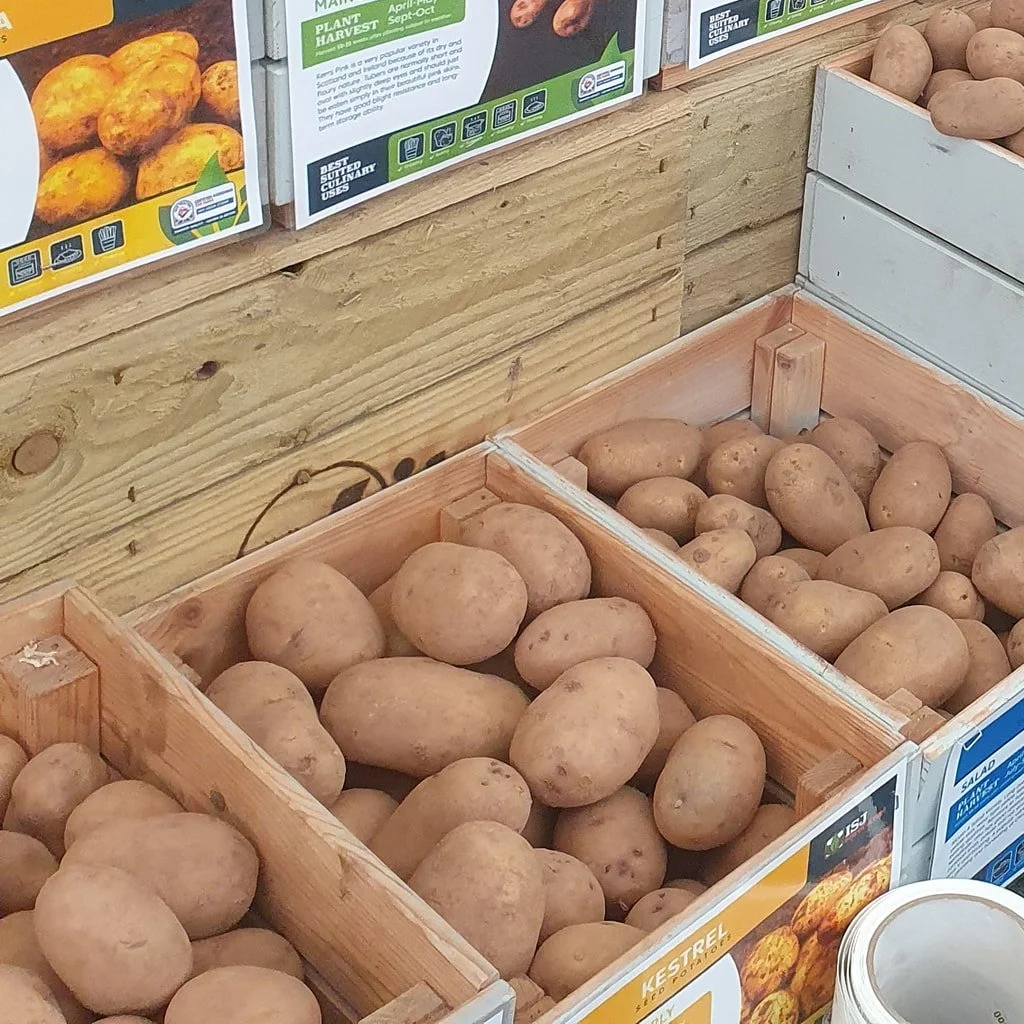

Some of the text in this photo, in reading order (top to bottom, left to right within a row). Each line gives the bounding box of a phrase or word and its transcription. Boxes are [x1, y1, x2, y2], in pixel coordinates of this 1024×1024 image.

[315, 12, 361, 35] PLANT
[315, 6, 435, 48] HARVEST Sept-Oct
[708, 8, 731, 22] BEST
[708, 14, 740, 31] SUITED
[708, 17, 750, 39] CULINARY
[708, 32, 729, 47] USES
[320, 156, 349, 175] BEST
[320, 161, 361, 184] SUITED
[321, 163, 376, 192] CULINARY
[321, 183, 349, 200] USES
[961, 759, 996, 793] SALAD
[956, 777, 1000, 820] HARVEST
[958, 778, 990, 810] PLANT
[845, 811, 868, 837] ISJ
[641, 923, 728, 998] KESTREL
[635, 933, 731, 1013] SEED POTATOES
